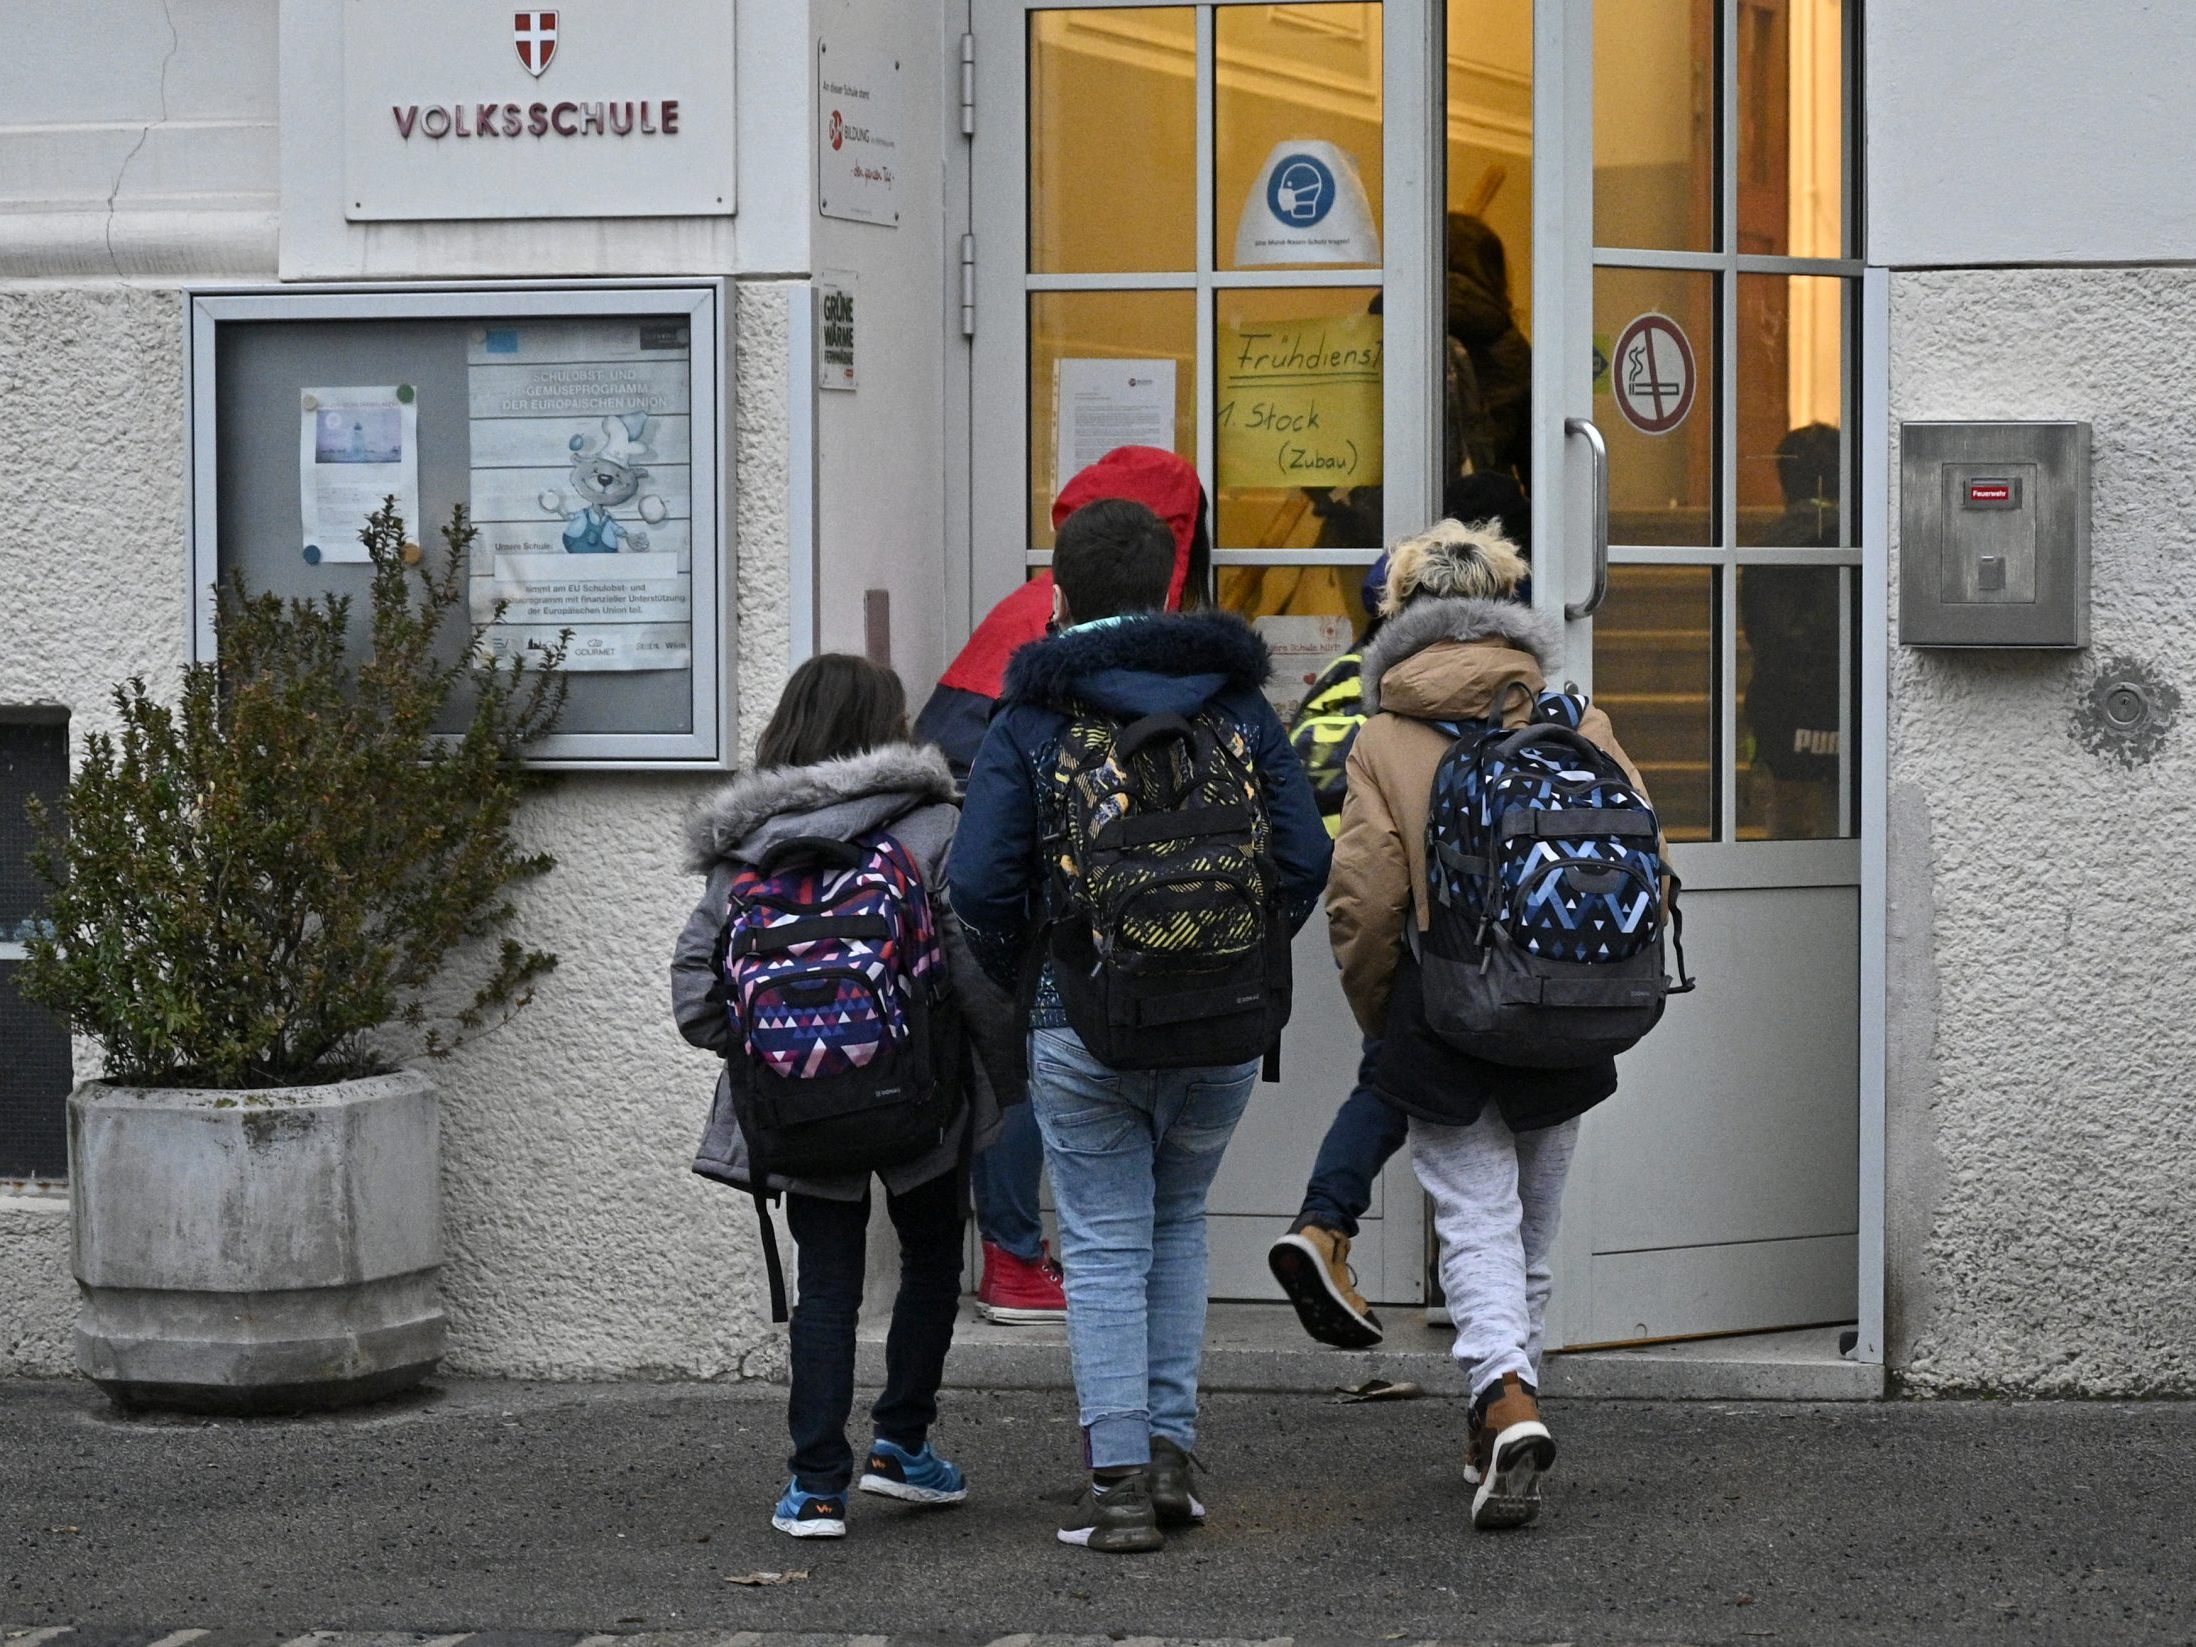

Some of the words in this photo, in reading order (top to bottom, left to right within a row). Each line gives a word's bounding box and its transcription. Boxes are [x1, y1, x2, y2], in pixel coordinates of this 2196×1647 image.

[392, 100, 679, 139] VOLKSSCHULE
[844, 124, 870, 143] BILDUNG
[823, 290, 854, 323] GRÜNE
[823, 321, 854, 348] WÄRME
[1238, 328, 1383, 369] Frühdienst
[610, 370, 636, 381] UND
[502, 399, 528, 411] DER
[626, 396, 667, 409] UNION
[1217, 401, 1236, 426] 1.
[1245, 400, 1319, 432] Stock
[1278, 440, 1358, 475] (Zubau)
[1972, 489, 2007, 497] Feuerwehr
[552, 585, 566, 593] am
[568, 584, 581, 592] EU
[630, 583, 646, 592] und
[565, 594, 579, 603] mit
[580, 594, 627, 603] finanzieller
[628, 594, 687, 604] Unterstützung
[527, 606, 541, 615] der
[543, 606, 600, 616] Europäischen
[602, 605, 627, 614] Union
[574, 648, 615, 657] GOURMET
